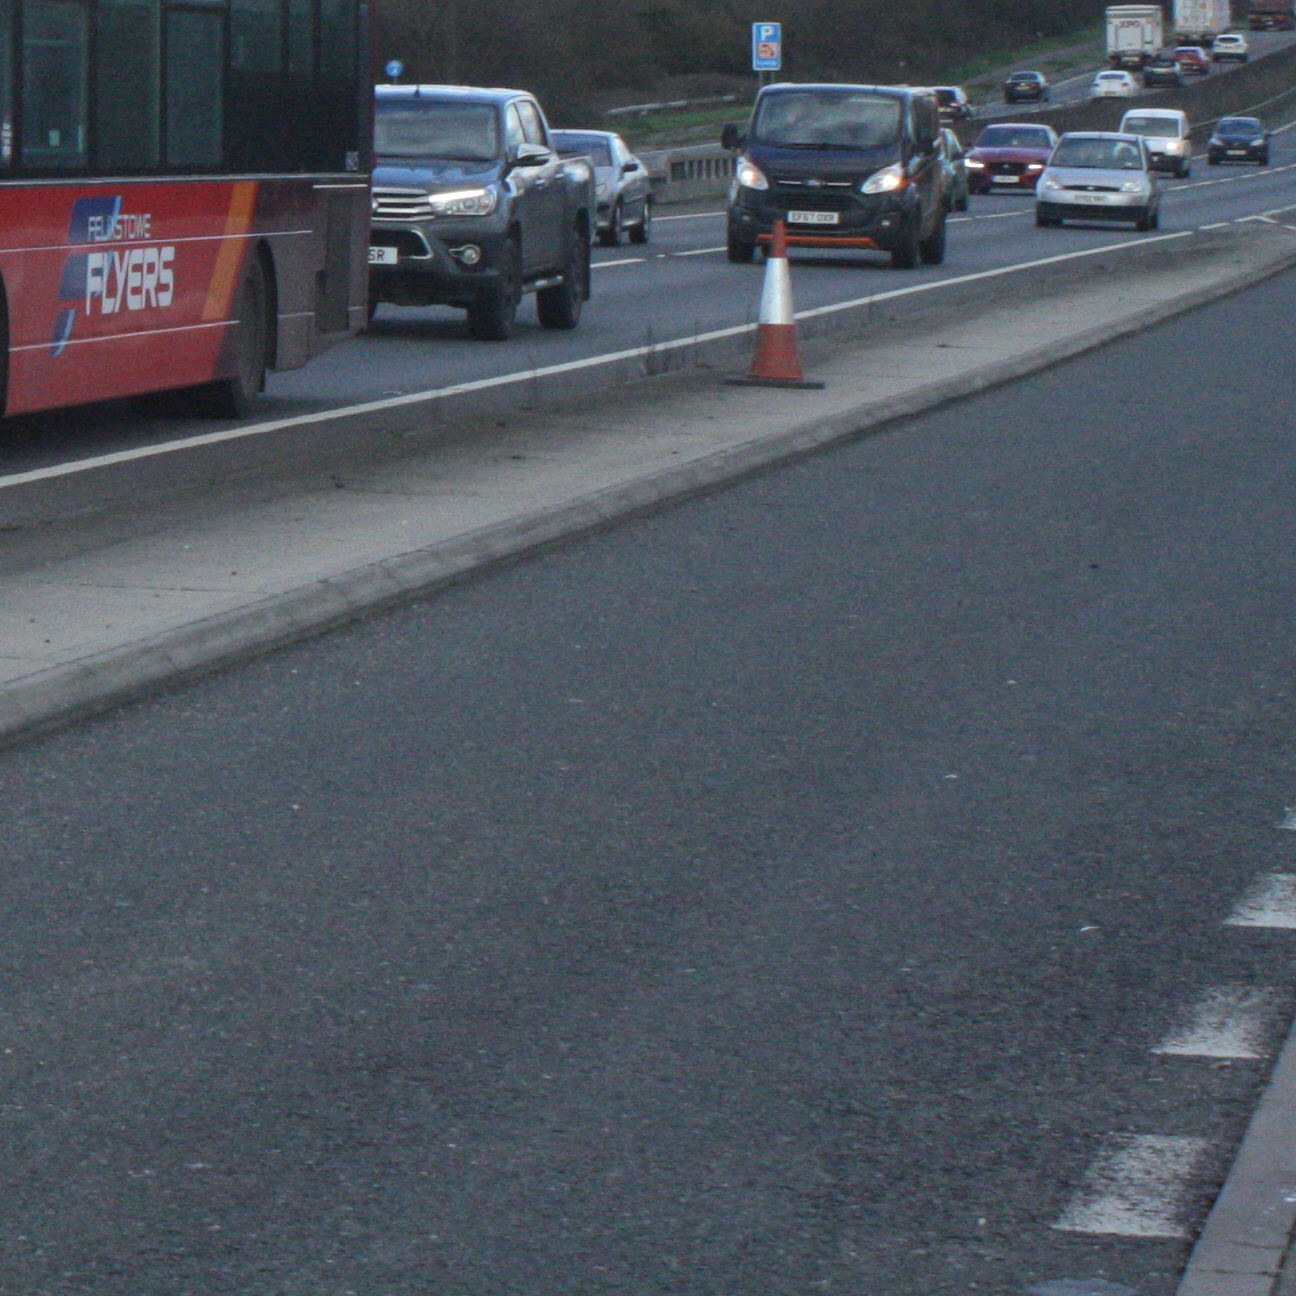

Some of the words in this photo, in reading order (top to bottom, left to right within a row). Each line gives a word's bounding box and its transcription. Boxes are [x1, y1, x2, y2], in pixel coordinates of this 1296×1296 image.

[760, 25, 775, 42] P
[87, 213, 152, 242] FELIXSTOWE
[85, 246, 176, 316] FLYERS
